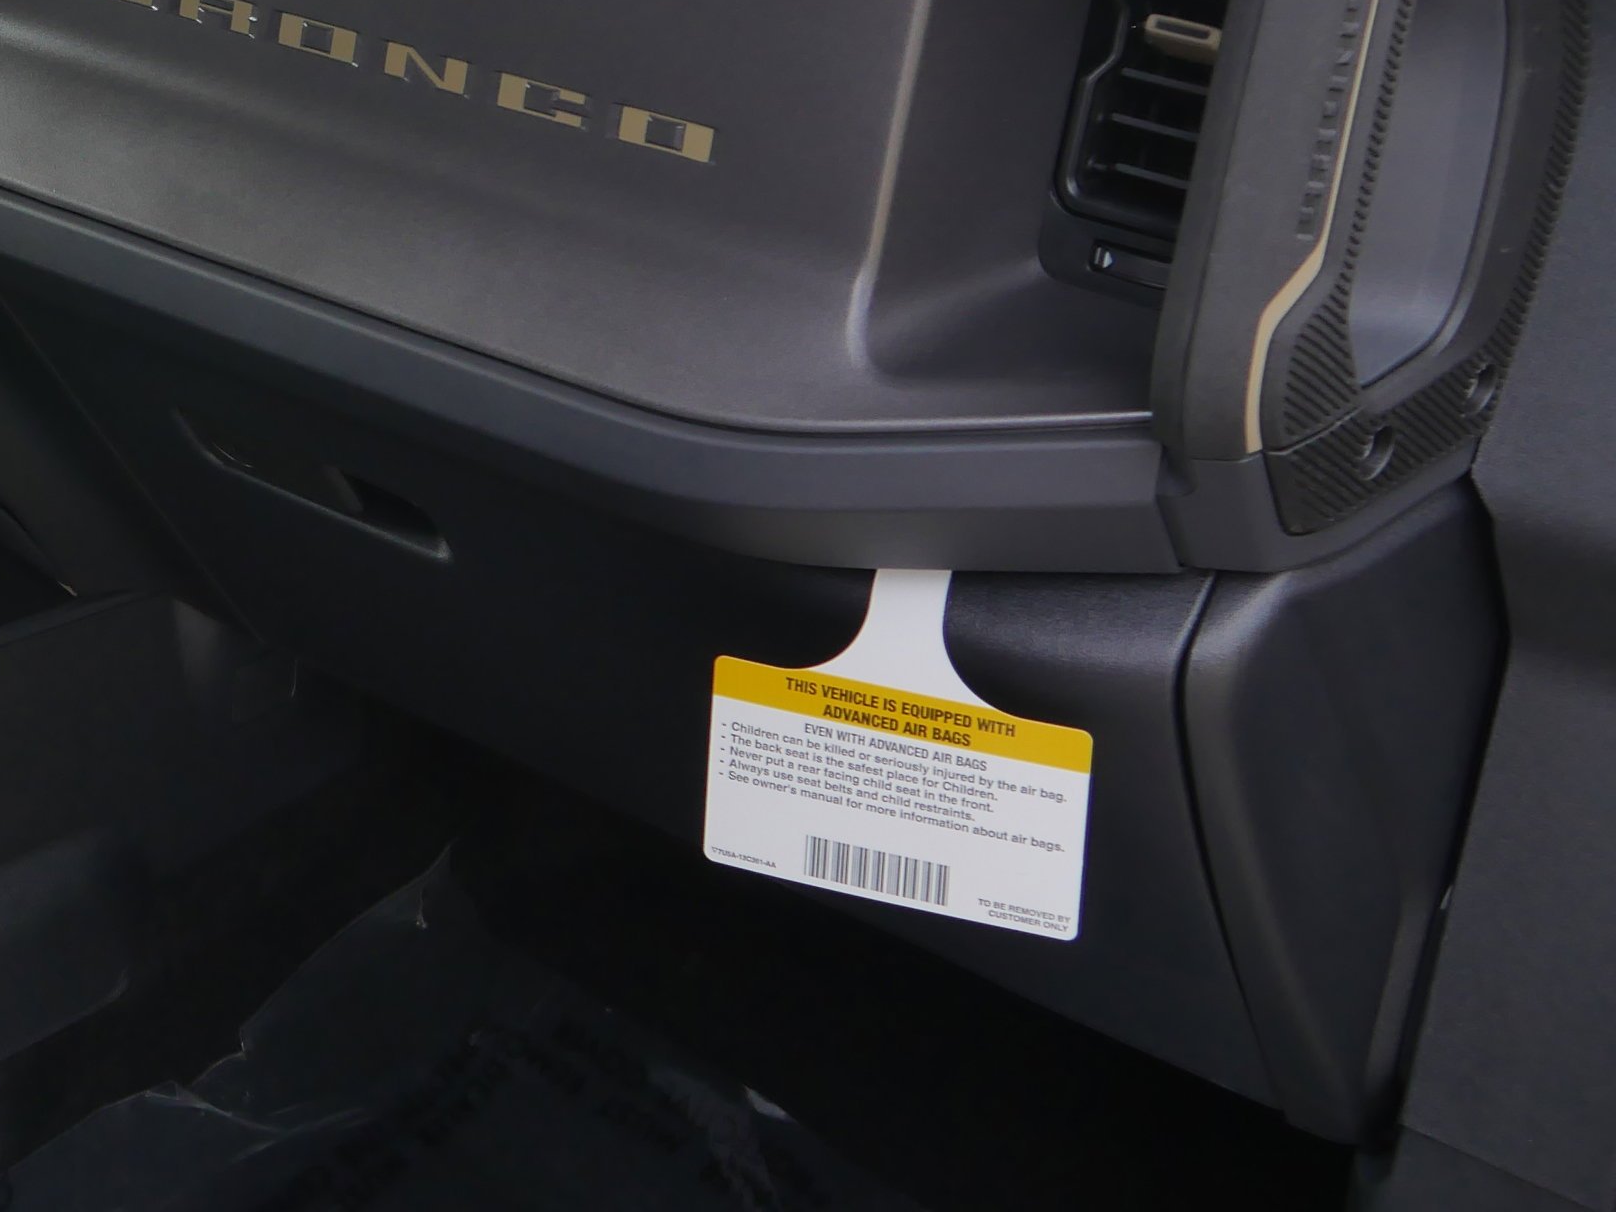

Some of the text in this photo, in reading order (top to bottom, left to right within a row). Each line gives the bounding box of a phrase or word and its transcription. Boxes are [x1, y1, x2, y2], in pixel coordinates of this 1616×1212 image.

[785, 676, 1015, 737] THIS VEHICLE IS EQUIPPED WITH
[822, 704, 970, 746] ADVANCED AIR BAGS
[730, 733, 997, 801] The back seat is the safest place for Children.
[731, 721, 1067, 803] Children can be killed or seriously injured by the air bag.
[804, 722, 987, 771] EVEN WITH ADVANCED AIR BAGS
[728, 758, 975, 821] Always use seat belts and child restraints.
[729, 745, 993, 812] Never put a rear facing child seat in the front.
[727, 770, 1064, 852] See owner's manual for more information about air bags.
[977, 897, 1071, 923] TO BE REMOVED BY
[987, 909, 1068, 932] CUSTOMER ONLY
